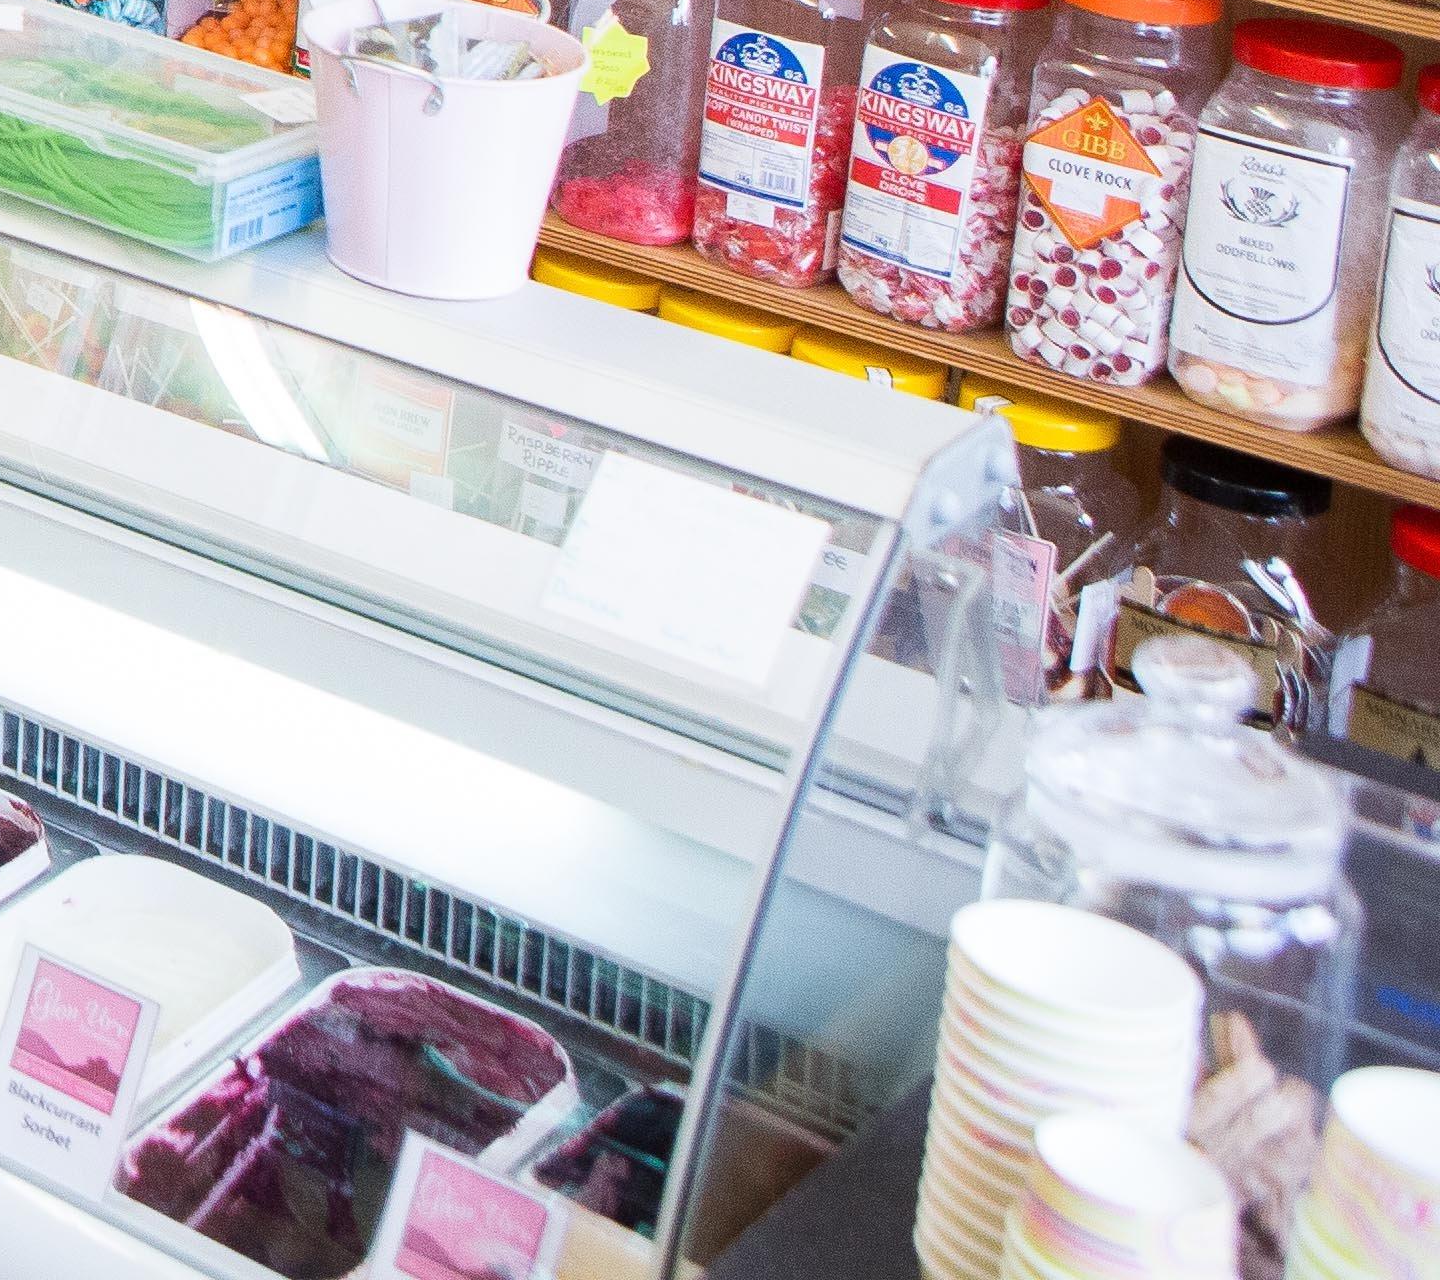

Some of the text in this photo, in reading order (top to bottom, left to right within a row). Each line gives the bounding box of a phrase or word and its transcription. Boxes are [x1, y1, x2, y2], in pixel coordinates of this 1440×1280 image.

[708, 61, 817, 108] KINGSWAY
[860, 89, 976, 142] KINGSWAY
[1062, 128, 1127, 160] GIBB
[880, 167, 927, 187] CLOVE
[1048, 158, 1132, 192] CLOVE ROCK
[1215, 241, 1297, 273] ODDFELLOWS
[1237, 234, 1275, 253] MIXED
[8, 1080, 103, 1136] Blackcurrant
[22, 1115, 72, 1150] Sorbet
